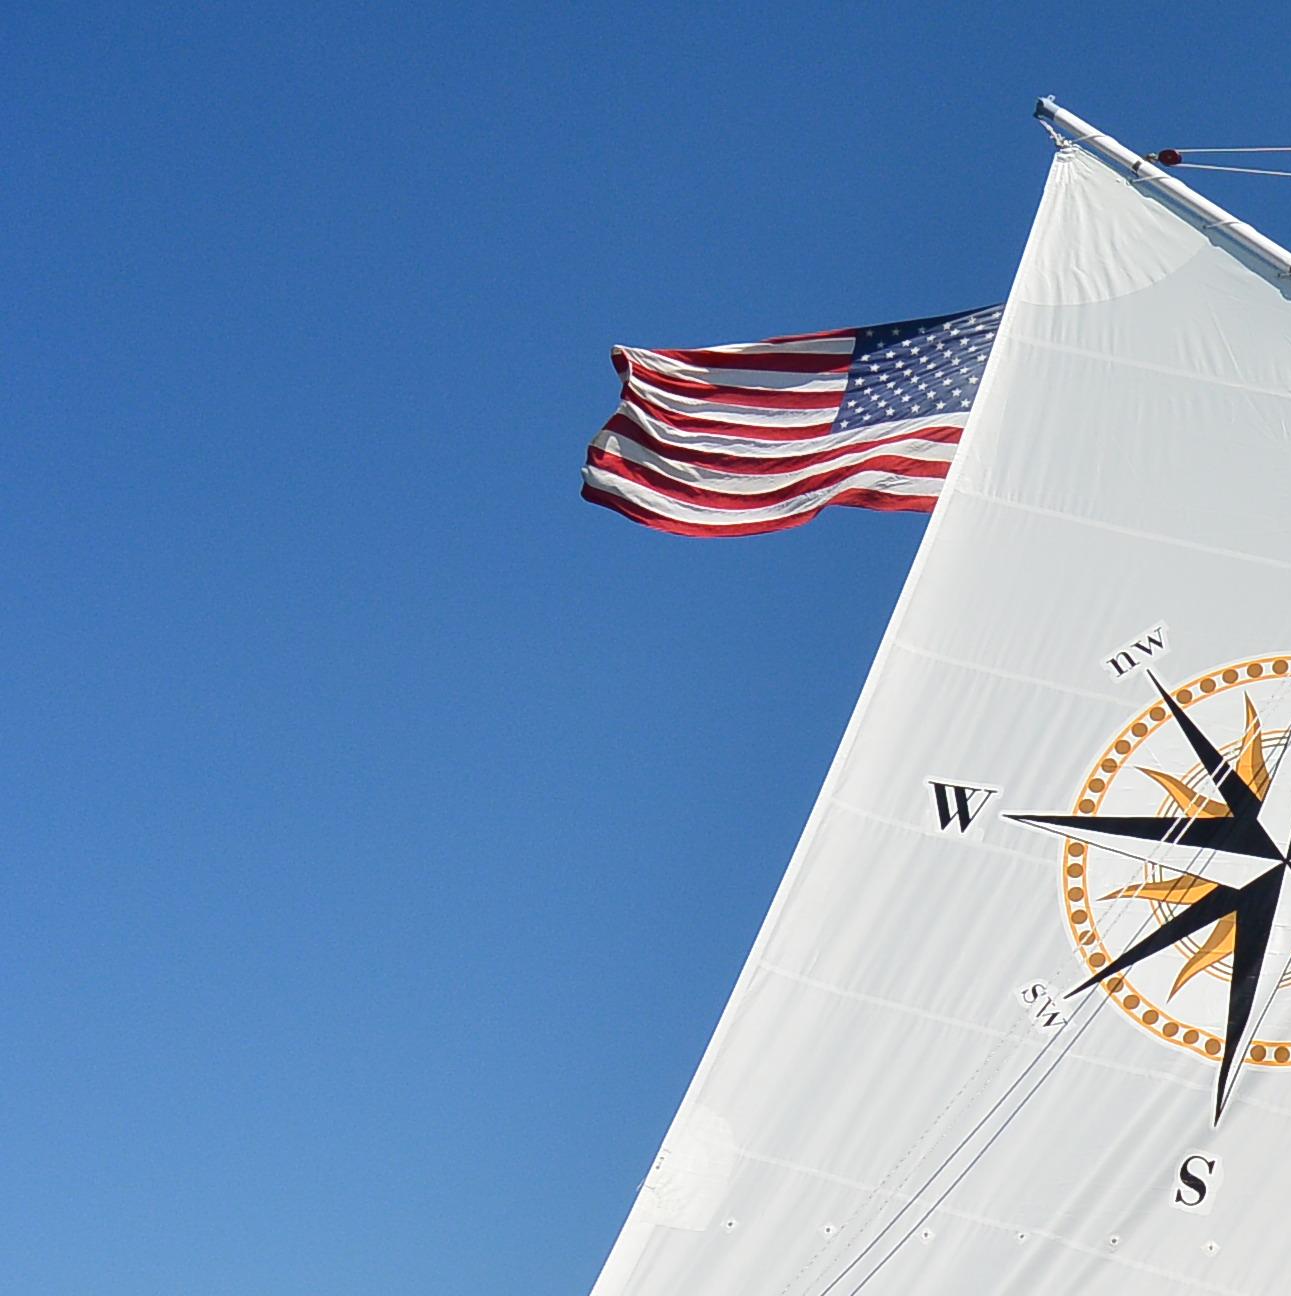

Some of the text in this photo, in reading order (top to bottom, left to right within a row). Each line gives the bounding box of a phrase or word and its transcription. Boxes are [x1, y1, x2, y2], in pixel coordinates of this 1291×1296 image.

[1106, 627, 1166, 678] nw
[927, 780, 997, 834] W
[1175, 1155, 1216, 1206] S
